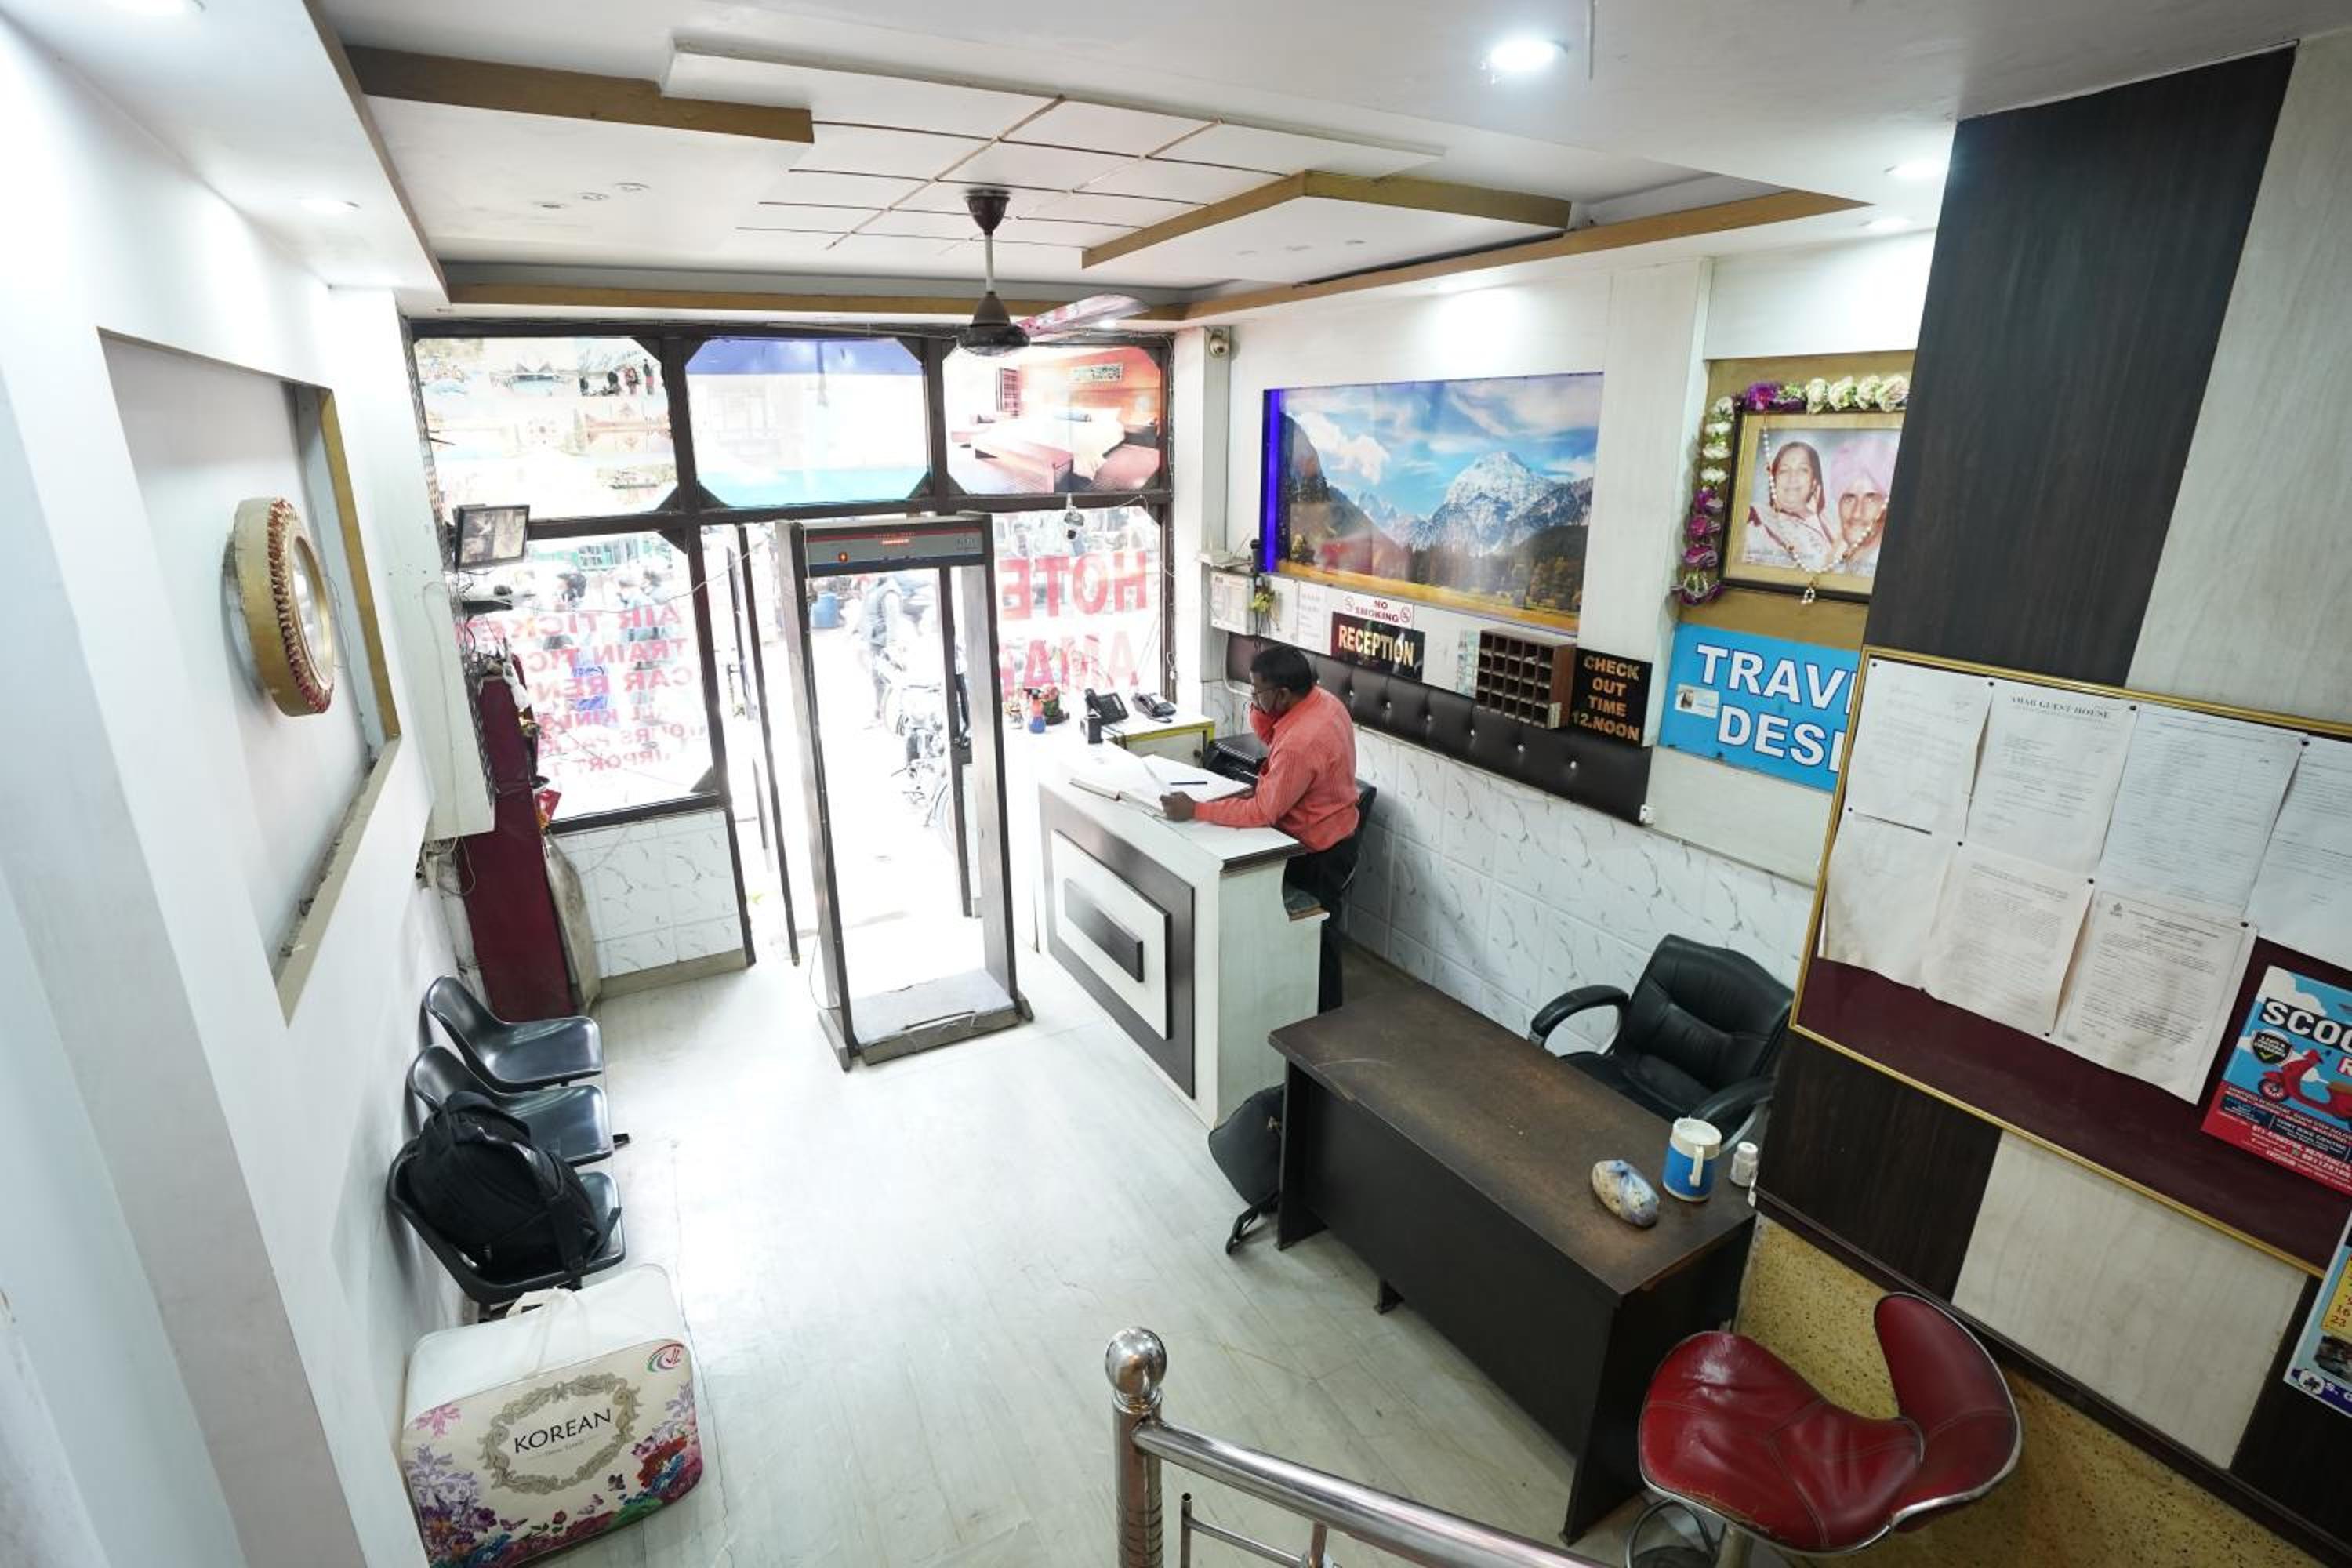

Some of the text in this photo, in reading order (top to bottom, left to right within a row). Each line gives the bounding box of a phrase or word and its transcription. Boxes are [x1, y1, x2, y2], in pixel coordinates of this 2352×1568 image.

[1354, 606, 1399, 623] SMOKING
[1374, 599, 1388, 610] NO
[1338, 624, 1414, 667] RECEPTION
[1584, 655, 1640, 681] CHECK
[1592, 677, 1628, 698] OUT
[1587, 695, 1628, 717] TIME
[514, 1407, 612, 1454] KOREAN
